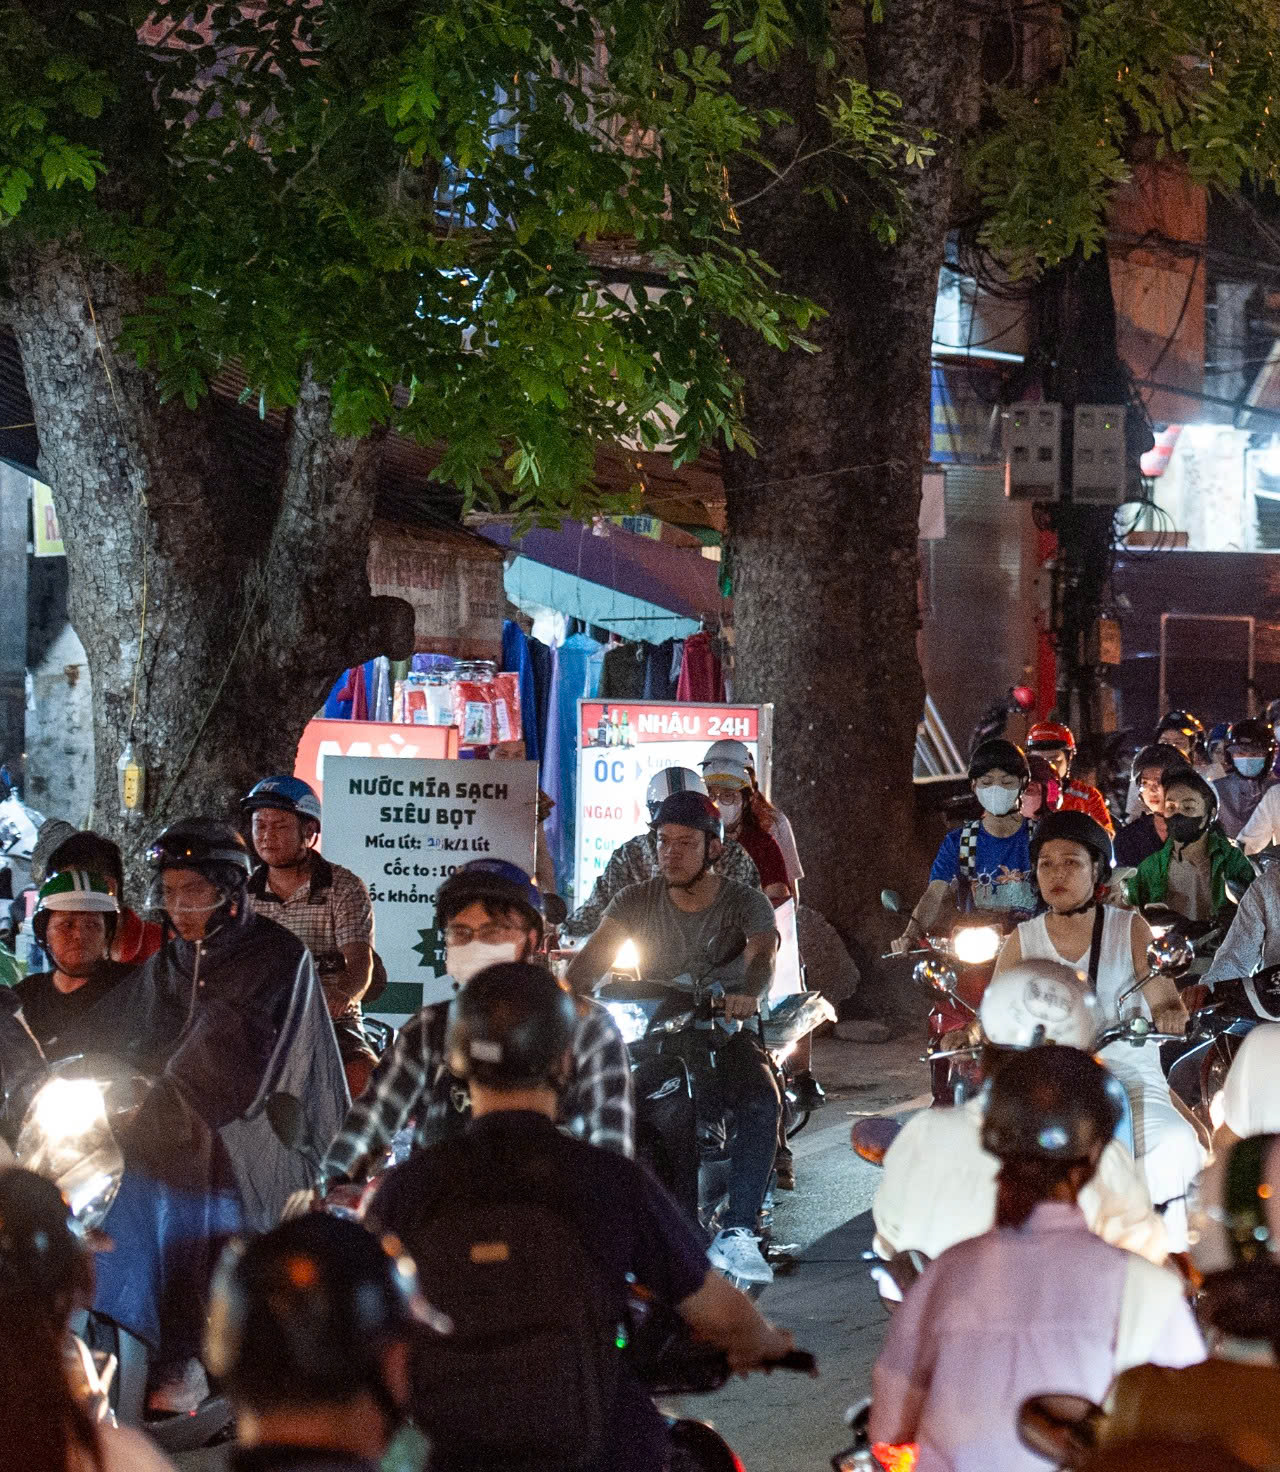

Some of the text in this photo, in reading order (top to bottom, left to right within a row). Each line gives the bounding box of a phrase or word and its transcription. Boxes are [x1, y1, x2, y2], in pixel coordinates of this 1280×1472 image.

[638, 712, 749, 738] NHẬU 24H
[349, 776, 508, 803] NƯỚC MÍA SẠCH
[380, 803, 476, 829] SIÊU BỌT
[583, 805, 623, 819] NGAO
[365, 833, 395, 849] Mía
[398, 834, 421, 850] lít:
[472, 836, 490, 851] lít
[383, 857, 410, 876] Cốc
[413, 865, 429, 877] to
[440, 865, 462, 877] 10
[368, 883, 385, 902] ốc
